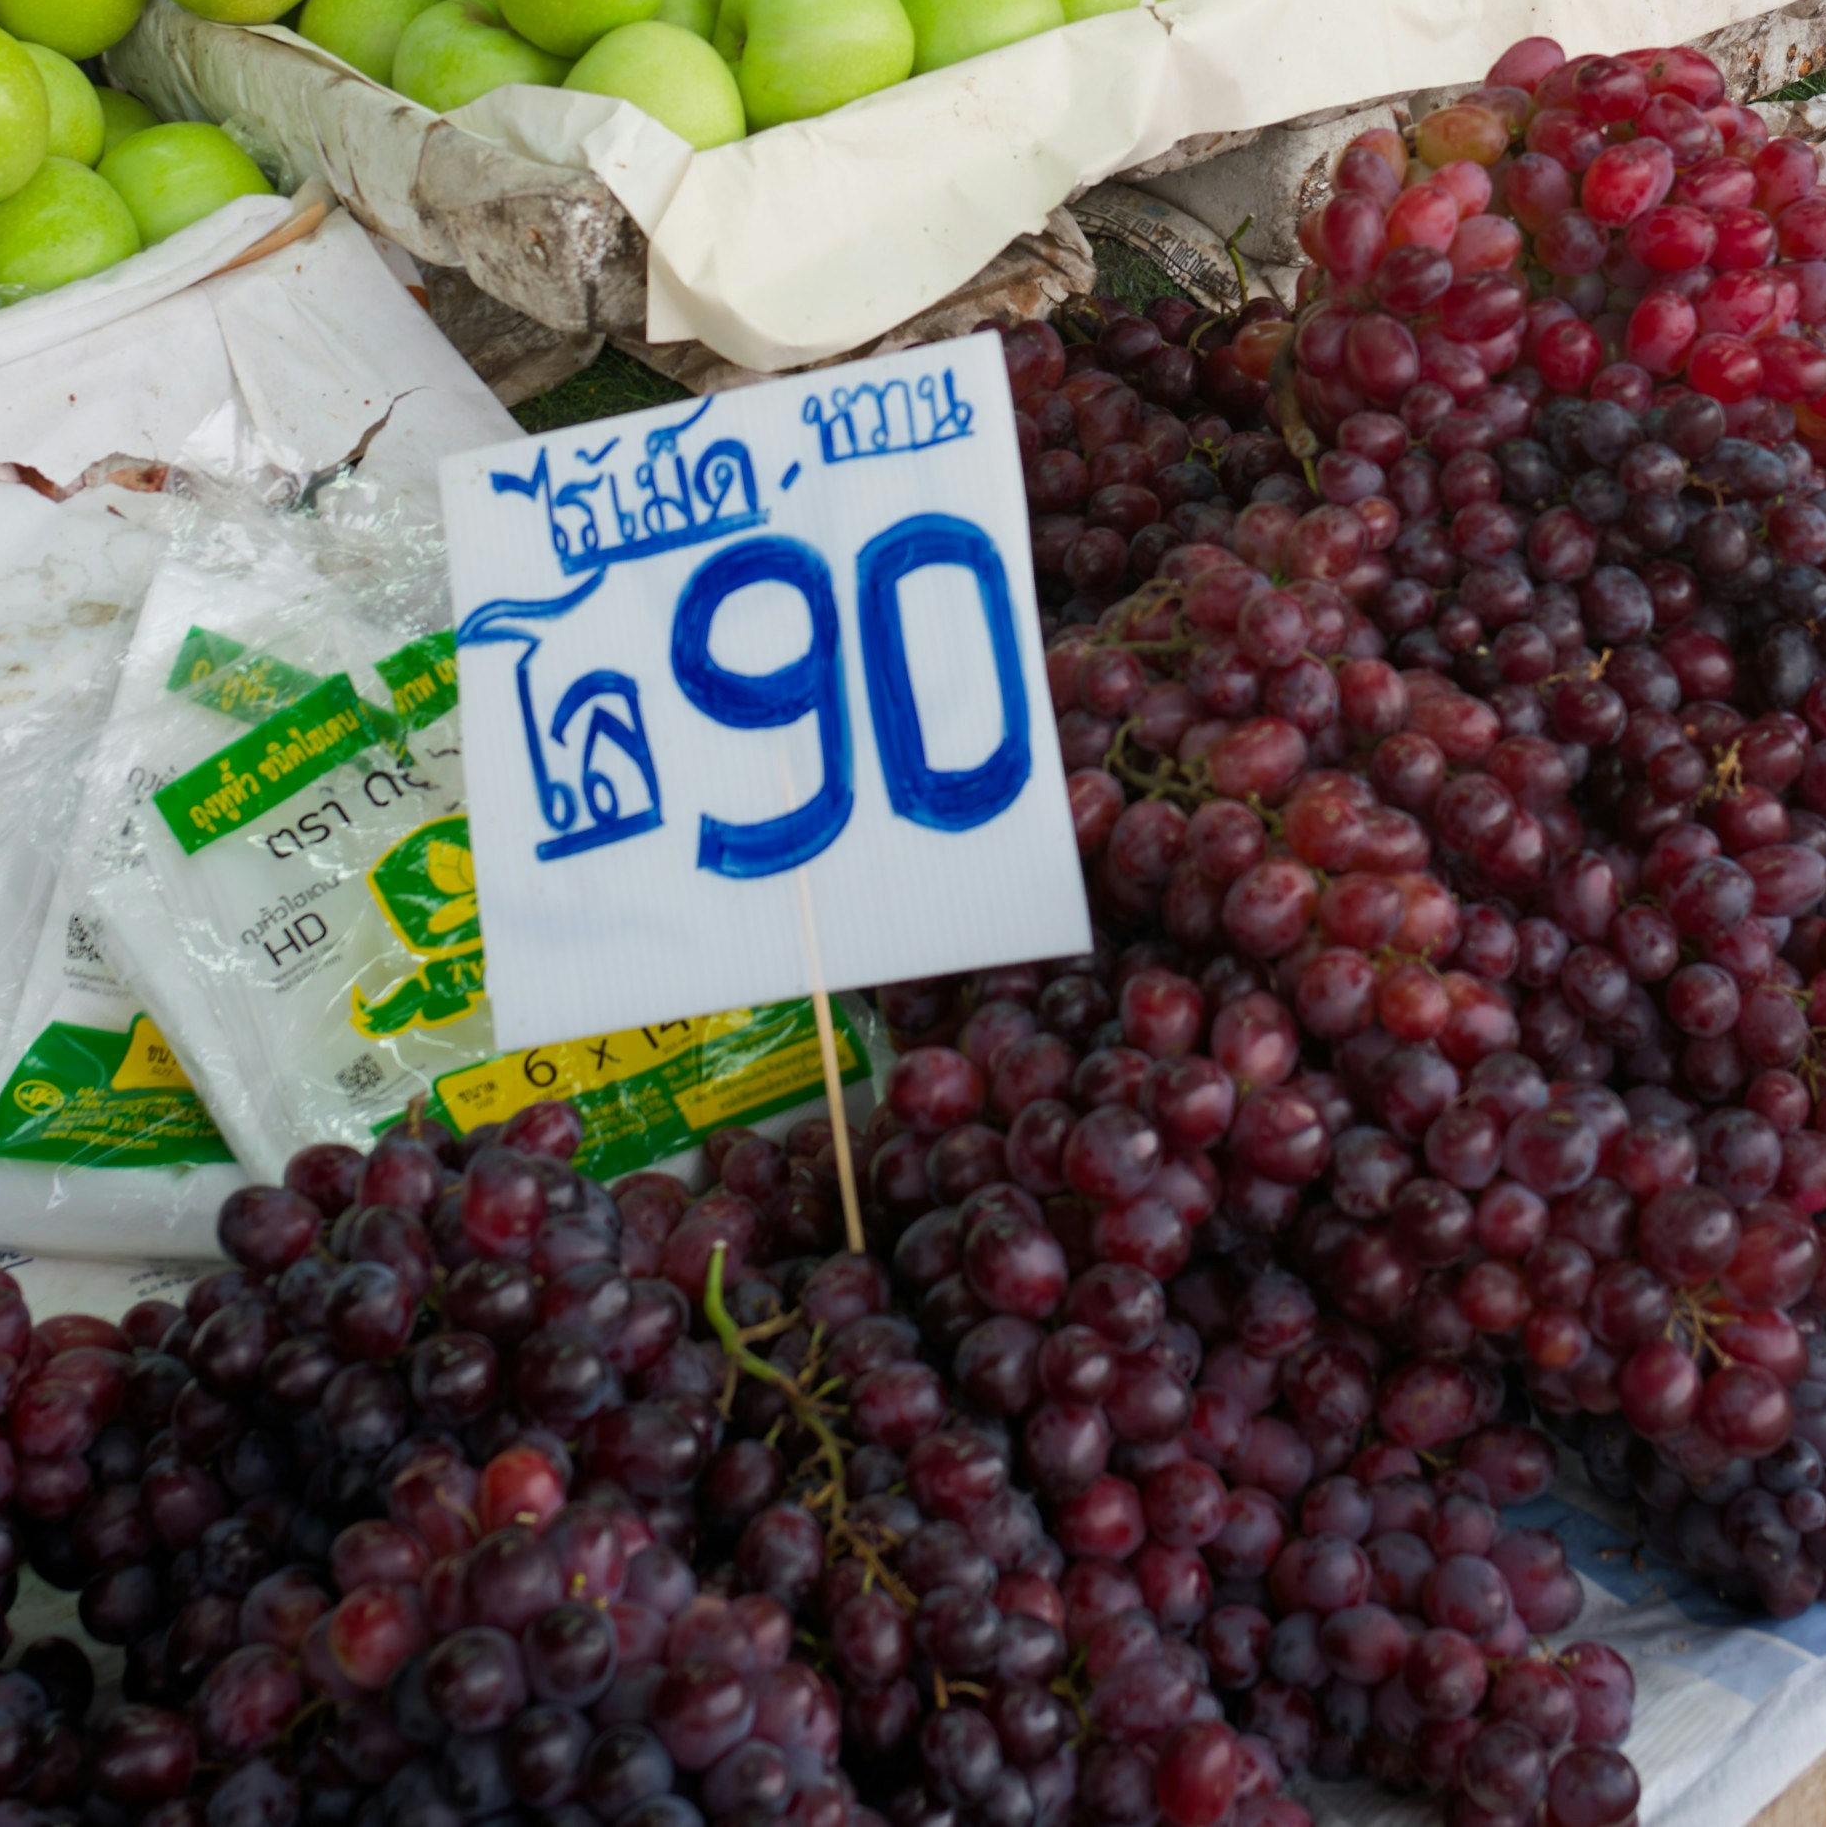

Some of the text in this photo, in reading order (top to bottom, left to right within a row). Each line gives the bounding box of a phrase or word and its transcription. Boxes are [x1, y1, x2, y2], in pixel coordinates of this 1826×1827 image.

[801, 369, 975, 464] หวาน
[456, 513, 1032, 880] โล 90
[188, 758, 262, 835] ถุงหูหิ้ว
[267, 800, 353, 860] ตรา
[262, 911, 329, 967] HD
[523, 1047, 558, 1088] 6
